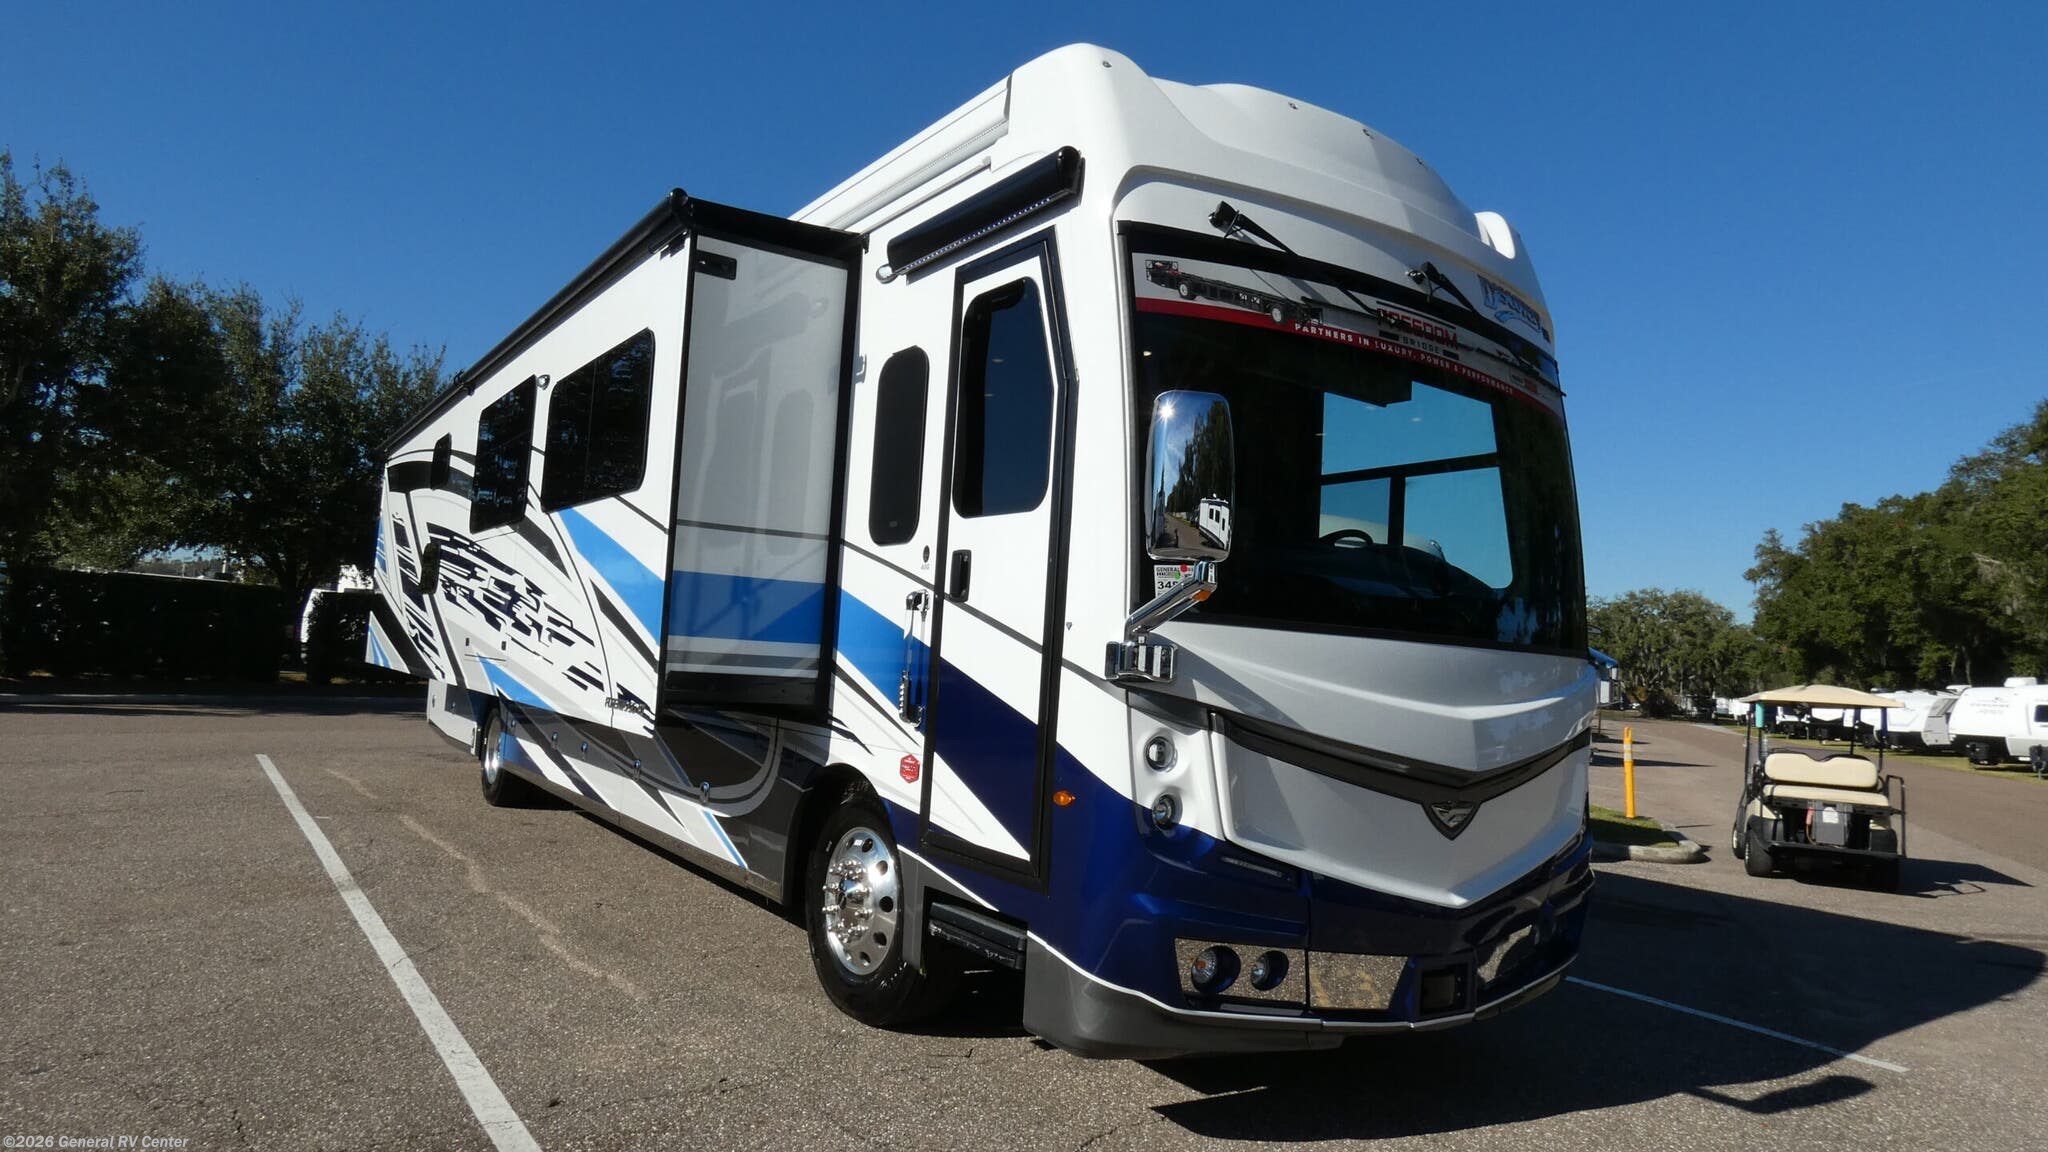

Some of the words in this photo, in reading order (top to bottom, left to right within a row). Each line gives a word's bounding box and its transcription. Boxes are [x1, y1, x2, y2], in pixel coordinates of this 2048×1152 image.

[1295, 323, 1353, 342] PARTNERS
[1358, 336, 1370, 346] IN
[1375, 340, 1417, 358] LUXURY,
[1420, 353, 1450, 370] POWER
[1462, 366, 1514, 395] PERFORMANCE
[1402, 336, 1439, 353] BRIDGE
